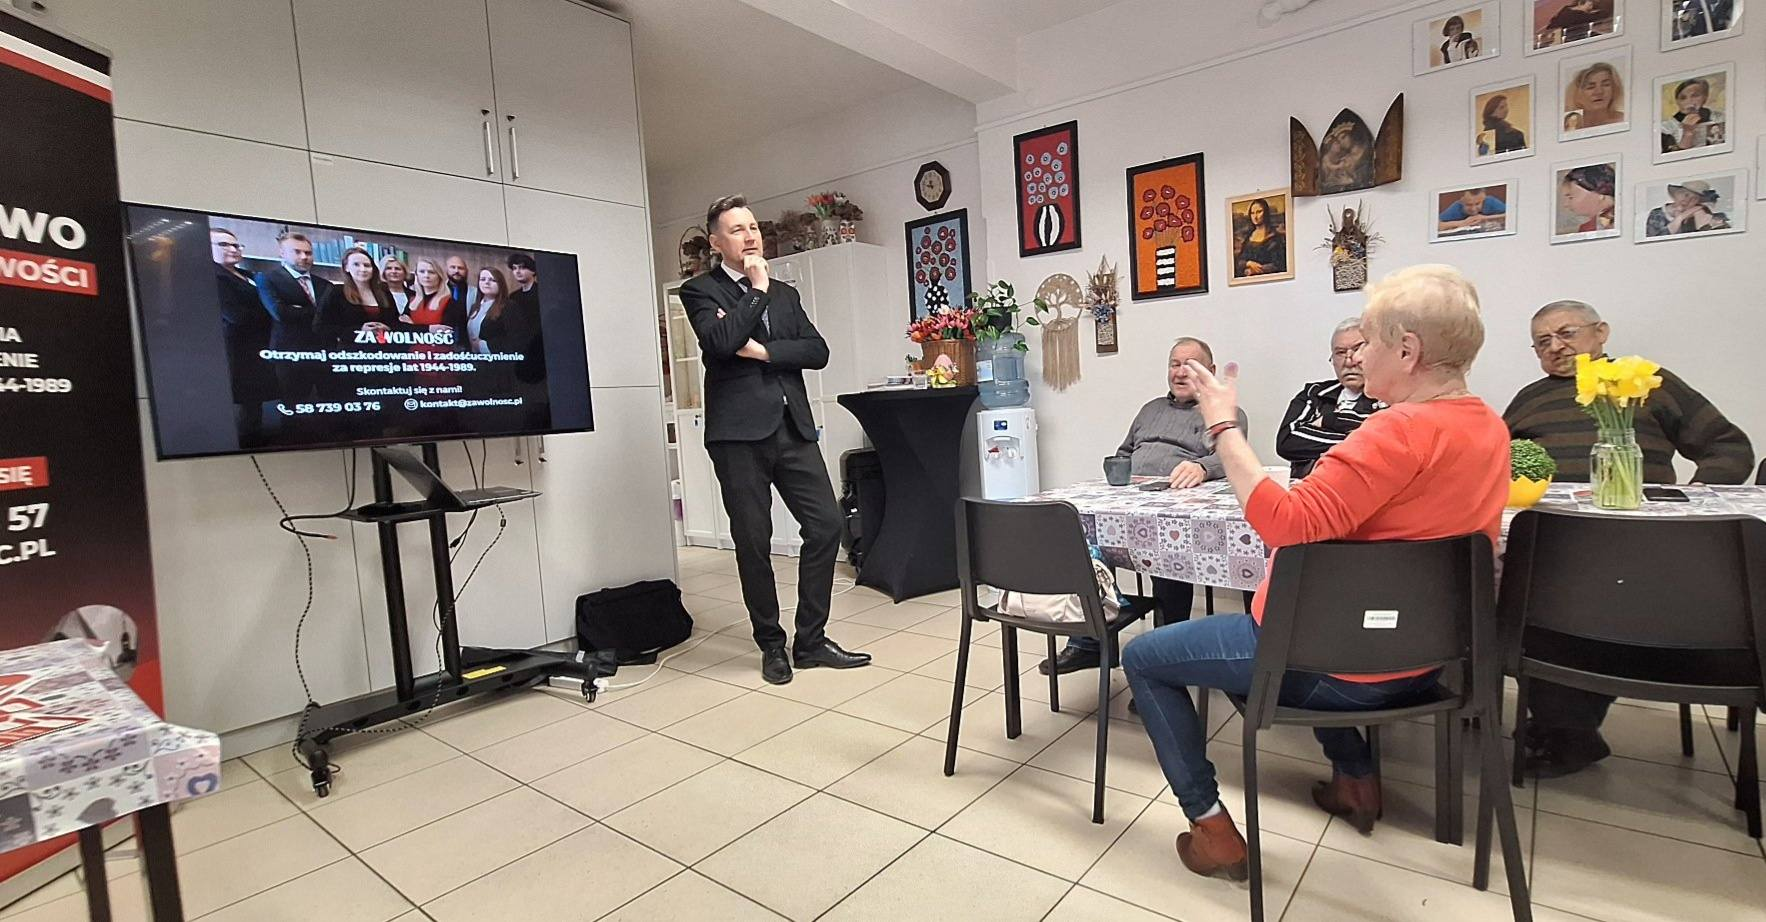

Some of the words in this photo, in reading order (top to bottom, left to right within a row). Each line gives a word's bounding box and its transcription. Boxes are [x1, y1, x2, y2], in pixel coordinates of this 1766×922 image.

[0, 352, 40, 369] NIE
[259, 350, 328, 362] Otrzymaj
[328, 350, 426, 361] odszkodowanie
[433, 351, 525, 362] zadośćuczynienie
[332, 364, 349, 373] za
[350, 362, 401, 374] represje
[402, 362, 419, 372] lat
[356, 386, 413, 396] Skontaktuj
[414, 386, 428, 396] się
[436, 385, 463, 394] nami!
[295, 403, 315, 414] 58
[316, 402, 343, 414] 739
[344, 401, 363, 412] 03
[363, 401, 381, 411] 76
[420, 397, 523, 409] kontakt@zawolnosc.pl
[8, 502, 50, 532] 57
